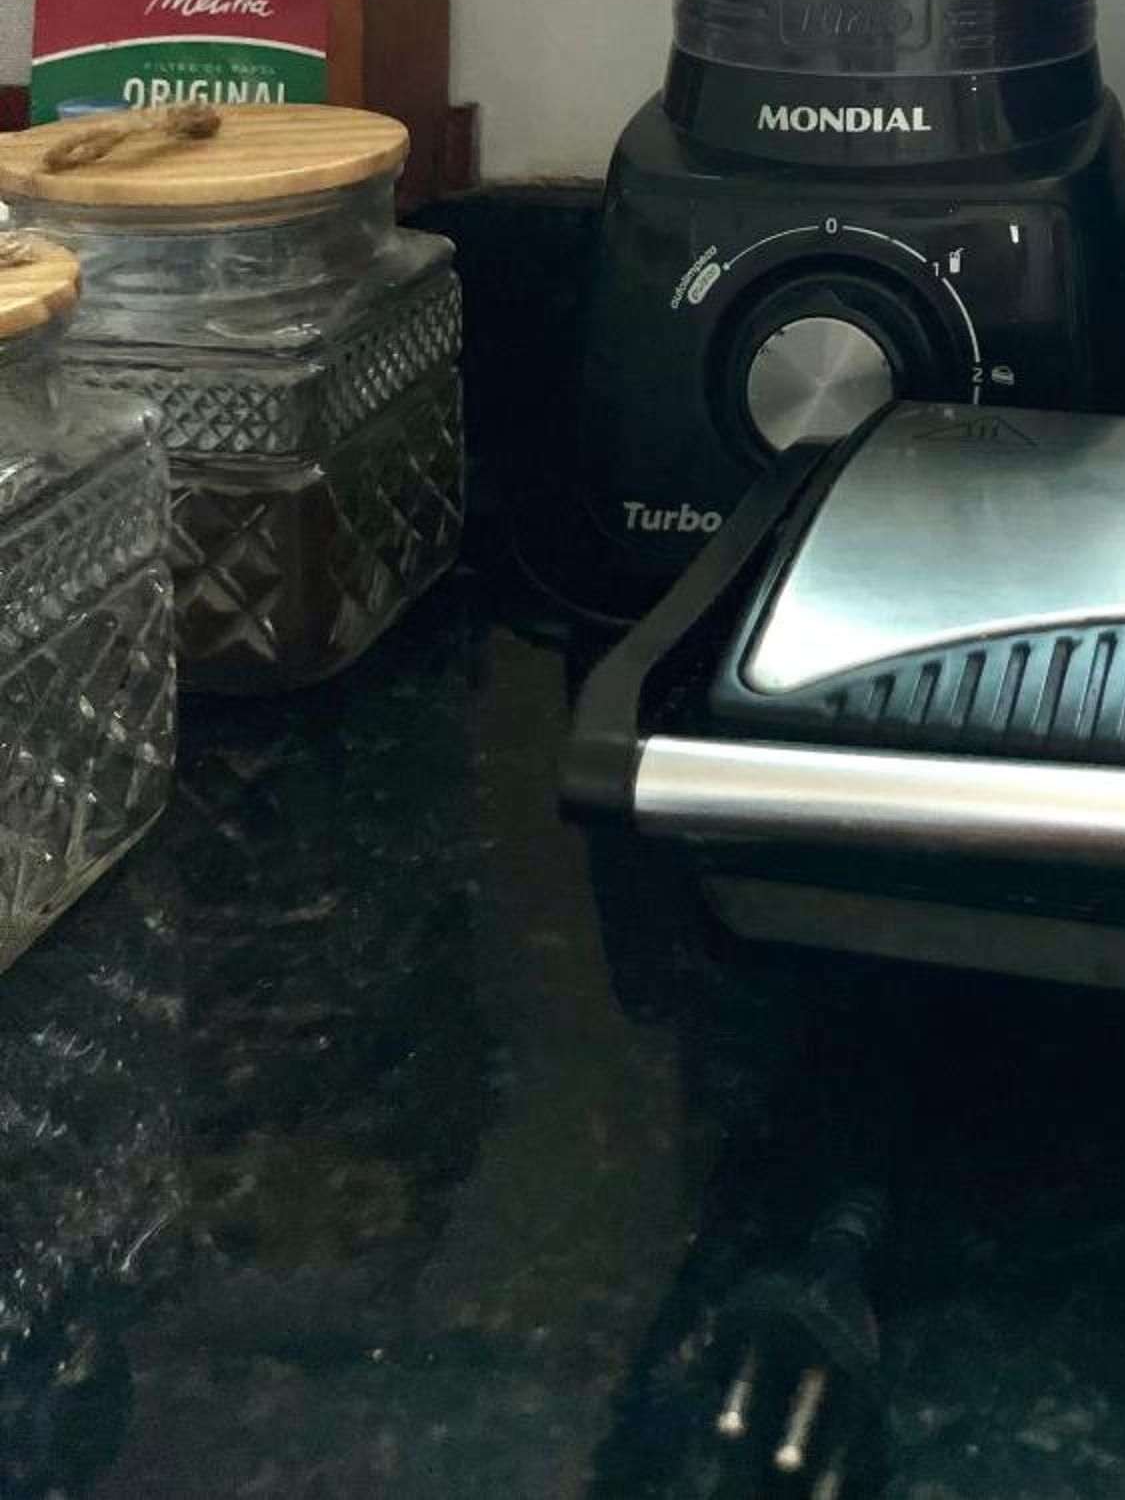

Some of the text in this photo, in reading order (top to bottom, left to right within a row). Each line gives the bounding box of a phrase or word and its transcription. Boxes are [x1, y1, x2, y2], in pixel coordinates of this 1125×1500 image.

[758, 104, 931, 132] MONDIAL
[825, 217, 838, 234] 0
[932, 261, 940, 277] 1
[972, 367, 983, 383] 2
[624, 502, 722, 532] Turbo
